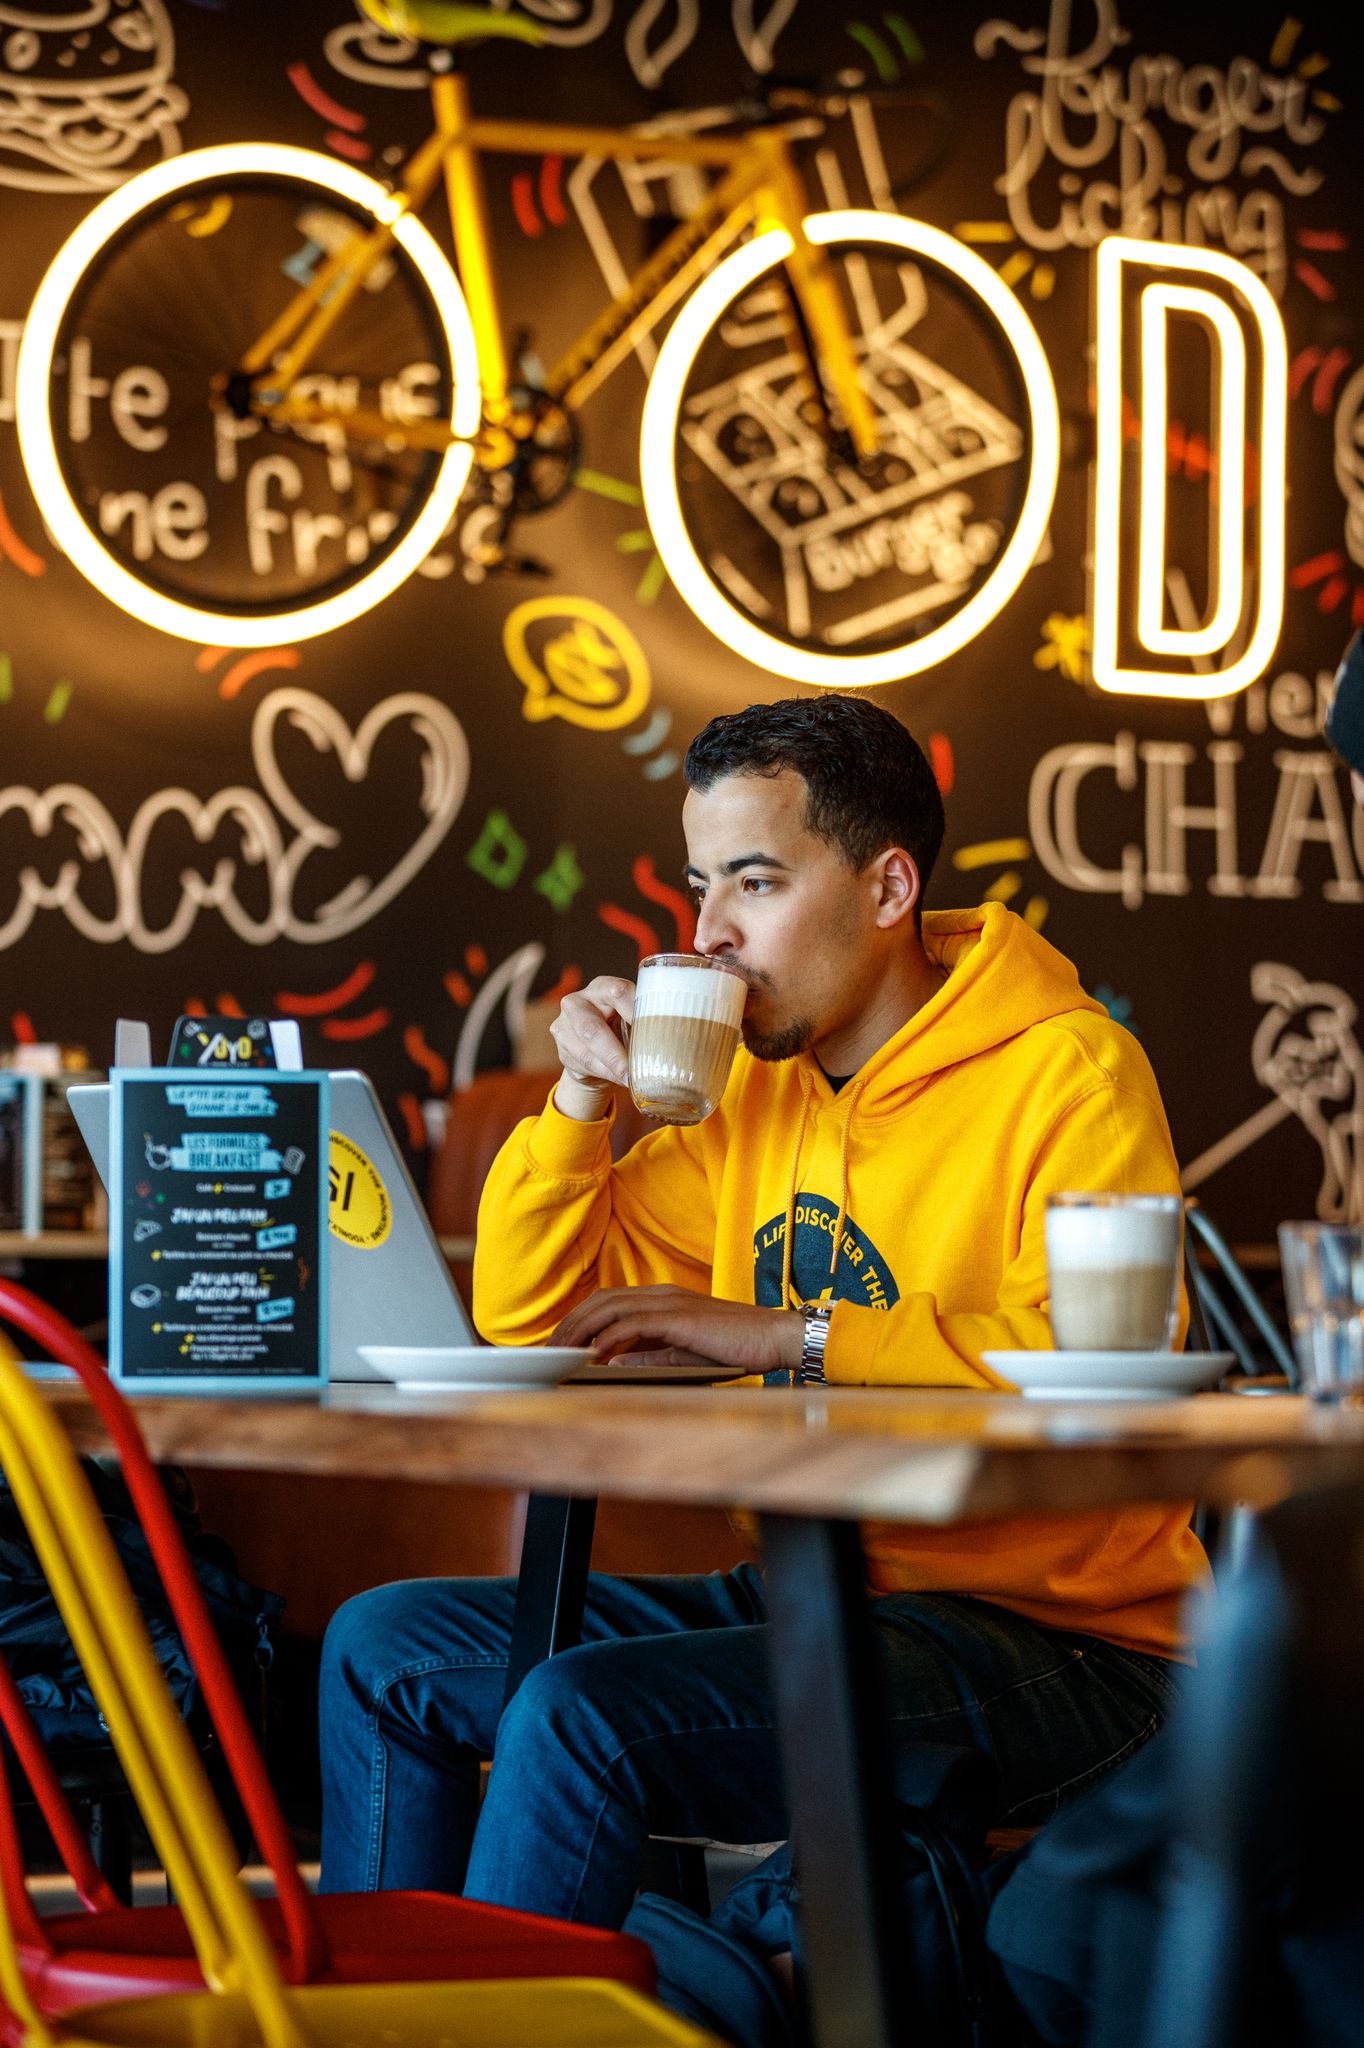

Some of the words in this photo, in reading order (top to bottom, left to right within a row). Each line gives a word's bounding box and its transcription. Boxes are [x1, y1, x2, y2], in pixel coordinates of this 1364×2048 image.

[1028, 730, 1364, 912] CHA
[188, 1152, 261, 1168] BREAKFAST
[763, 1222, 788, 1249] LIF
[861, 1265, 889, 1311] THE
